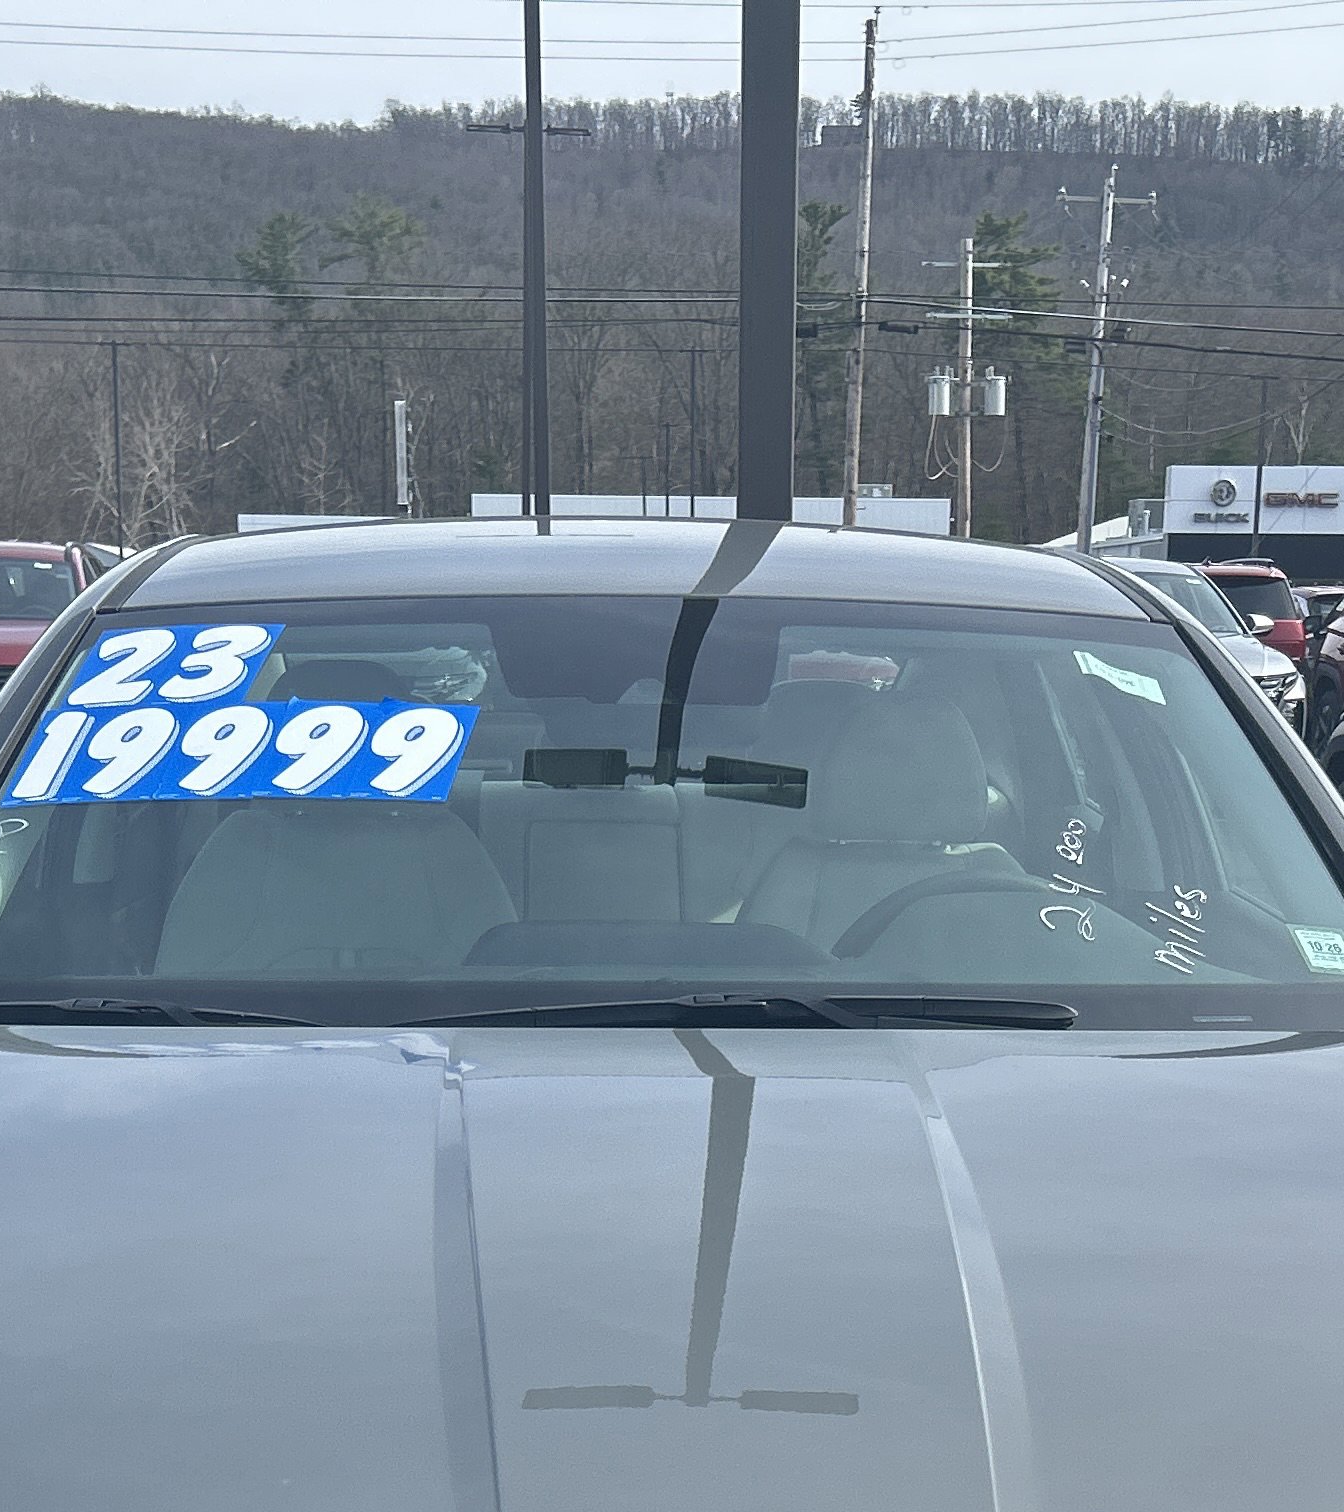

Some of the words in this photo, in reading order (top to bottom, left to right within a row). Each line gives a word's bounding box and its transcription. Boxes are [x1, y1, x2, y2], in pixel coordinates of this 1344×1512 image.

[1194, 513, 1249, 523] BUICK
[1264, 493, 1339, 508] GMC
[67, 625, 272, 708] 23
[11, 705, 465, 800] 19999
[1144, 885, 1207, 974] miles
